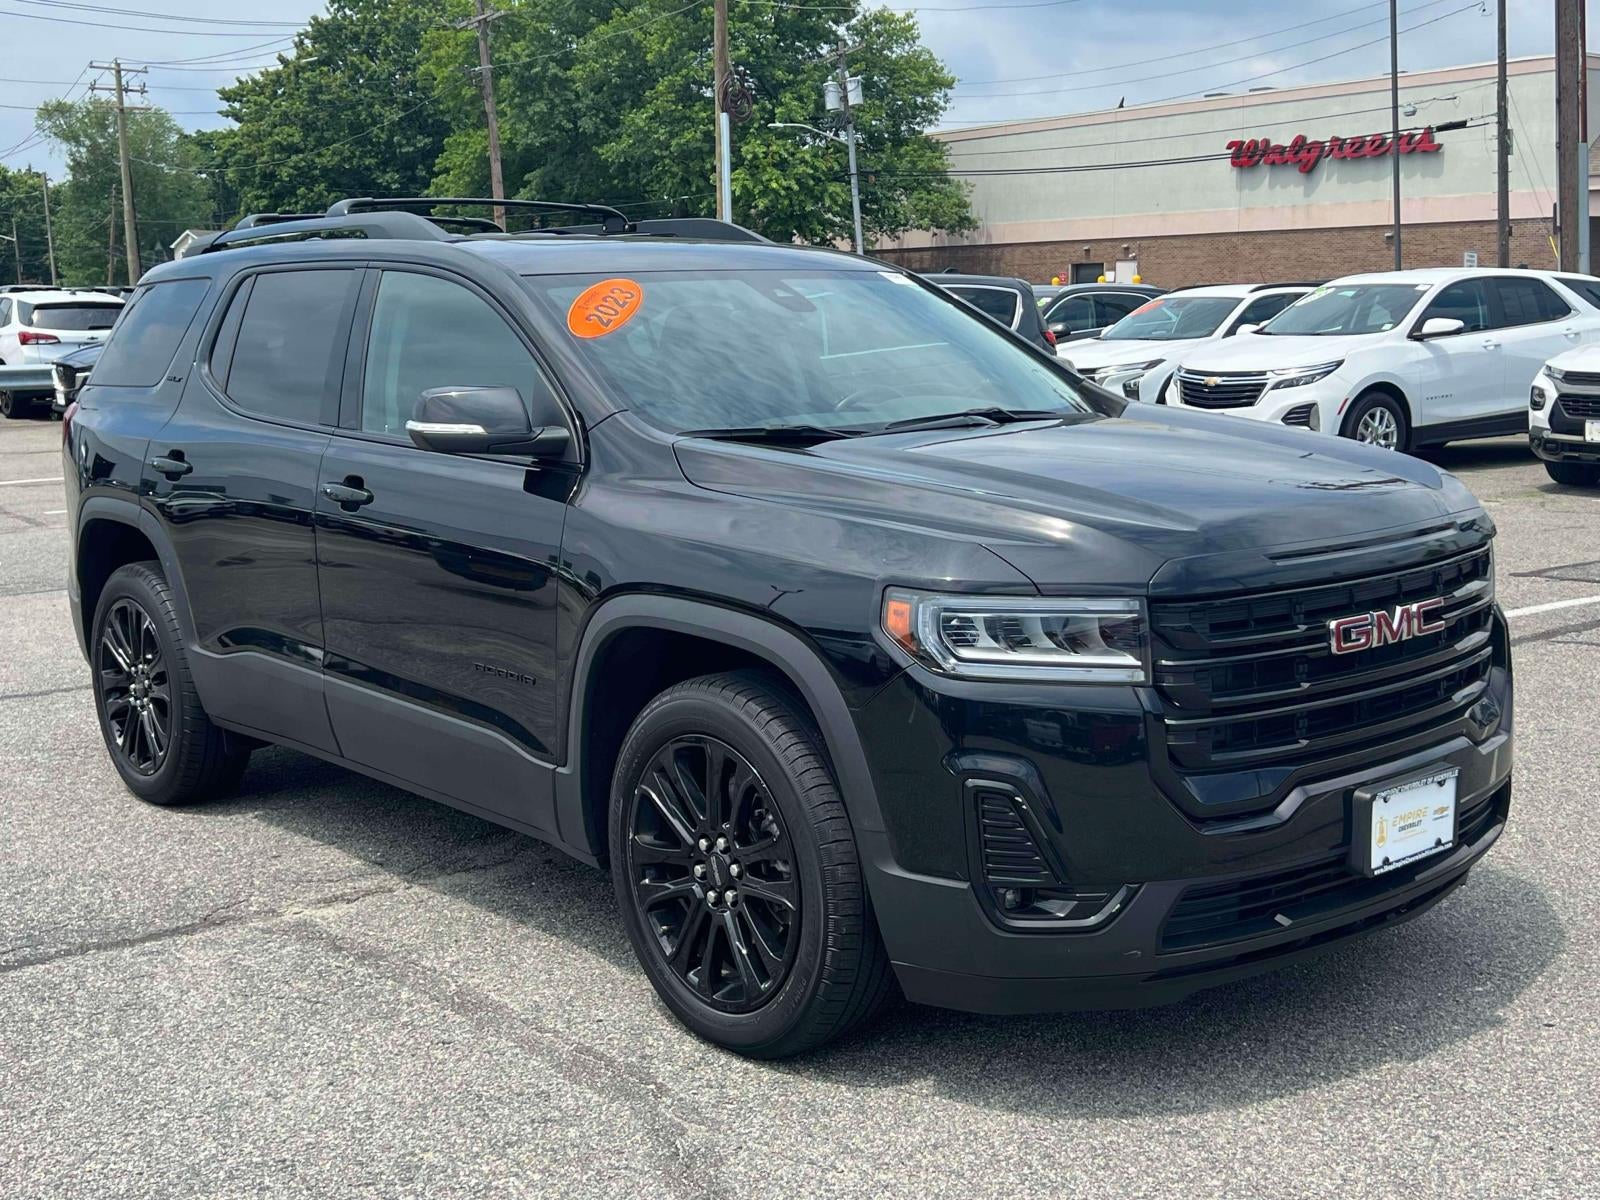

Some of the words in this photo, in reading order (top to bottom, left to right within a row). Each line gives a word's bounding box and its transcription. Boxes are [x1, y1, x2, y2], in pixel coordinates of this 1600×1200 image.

[1226, 127, 1443, 174] Walgreens
[585, 287, 634, 328] 2023
[1329, 597, 1446, 654] GMC
[1391, 806, 1429, 827] EMPIRE
